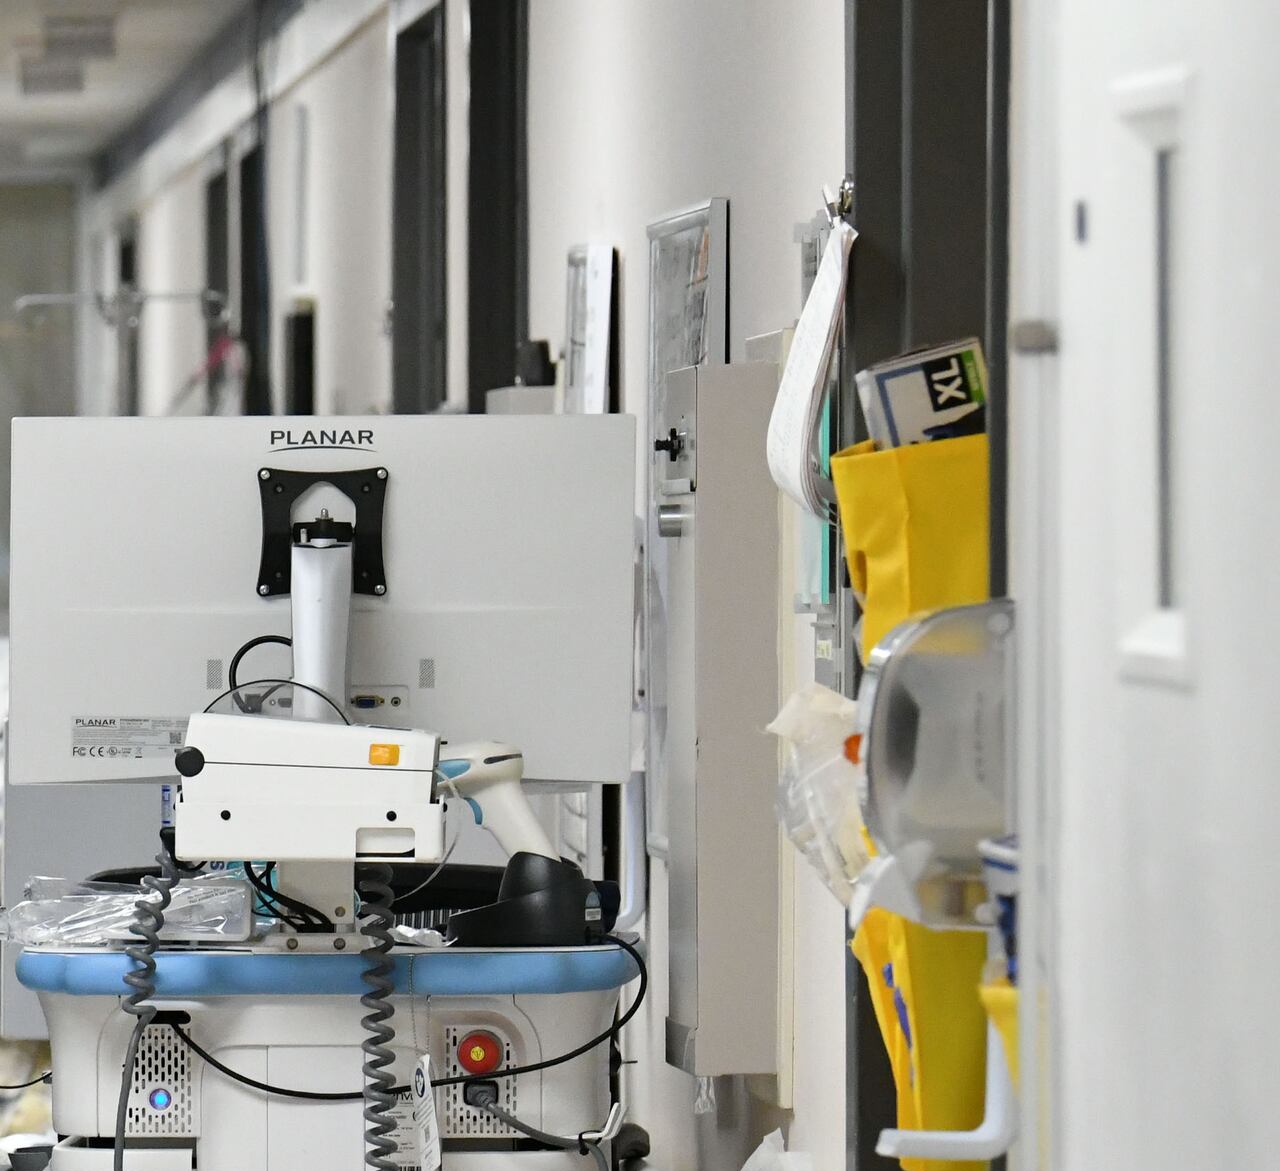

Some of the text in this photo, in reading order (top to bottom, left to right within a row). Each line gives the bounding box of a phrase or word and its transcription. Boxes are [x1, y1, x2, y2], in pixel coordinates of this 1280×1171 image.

[931, 357, 966, 404] XL
[270, 430, 374, 445] PLANAR
[75, 718, 116, 726] PLANAR
